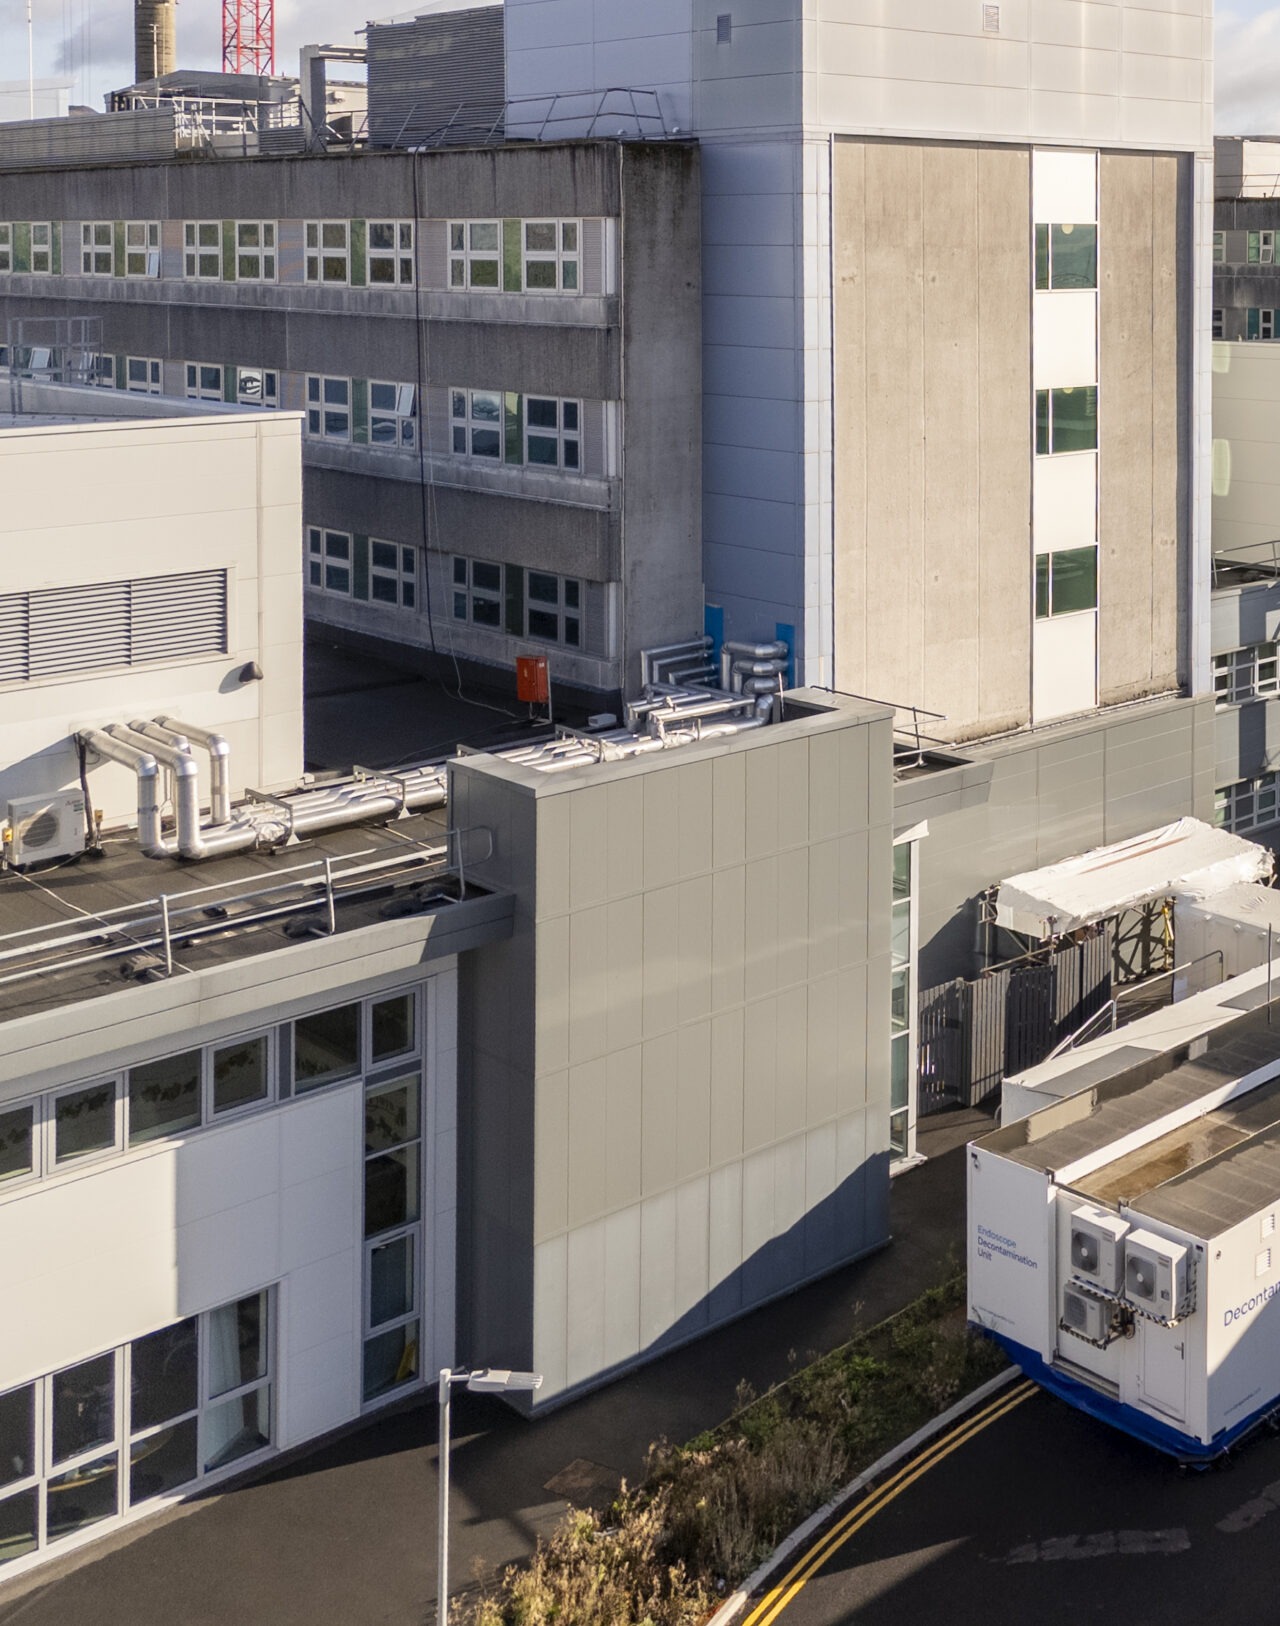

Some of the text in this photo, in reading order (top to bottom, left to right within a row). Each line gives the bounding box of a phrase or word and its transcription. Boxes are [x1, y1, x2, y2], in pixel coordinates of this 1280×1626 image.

[977, 1224, 1017, 1249] Endoscope
[977, 1236, 1038, 1269] Decontamination
[977, 1247, 992, 1261] Unit
